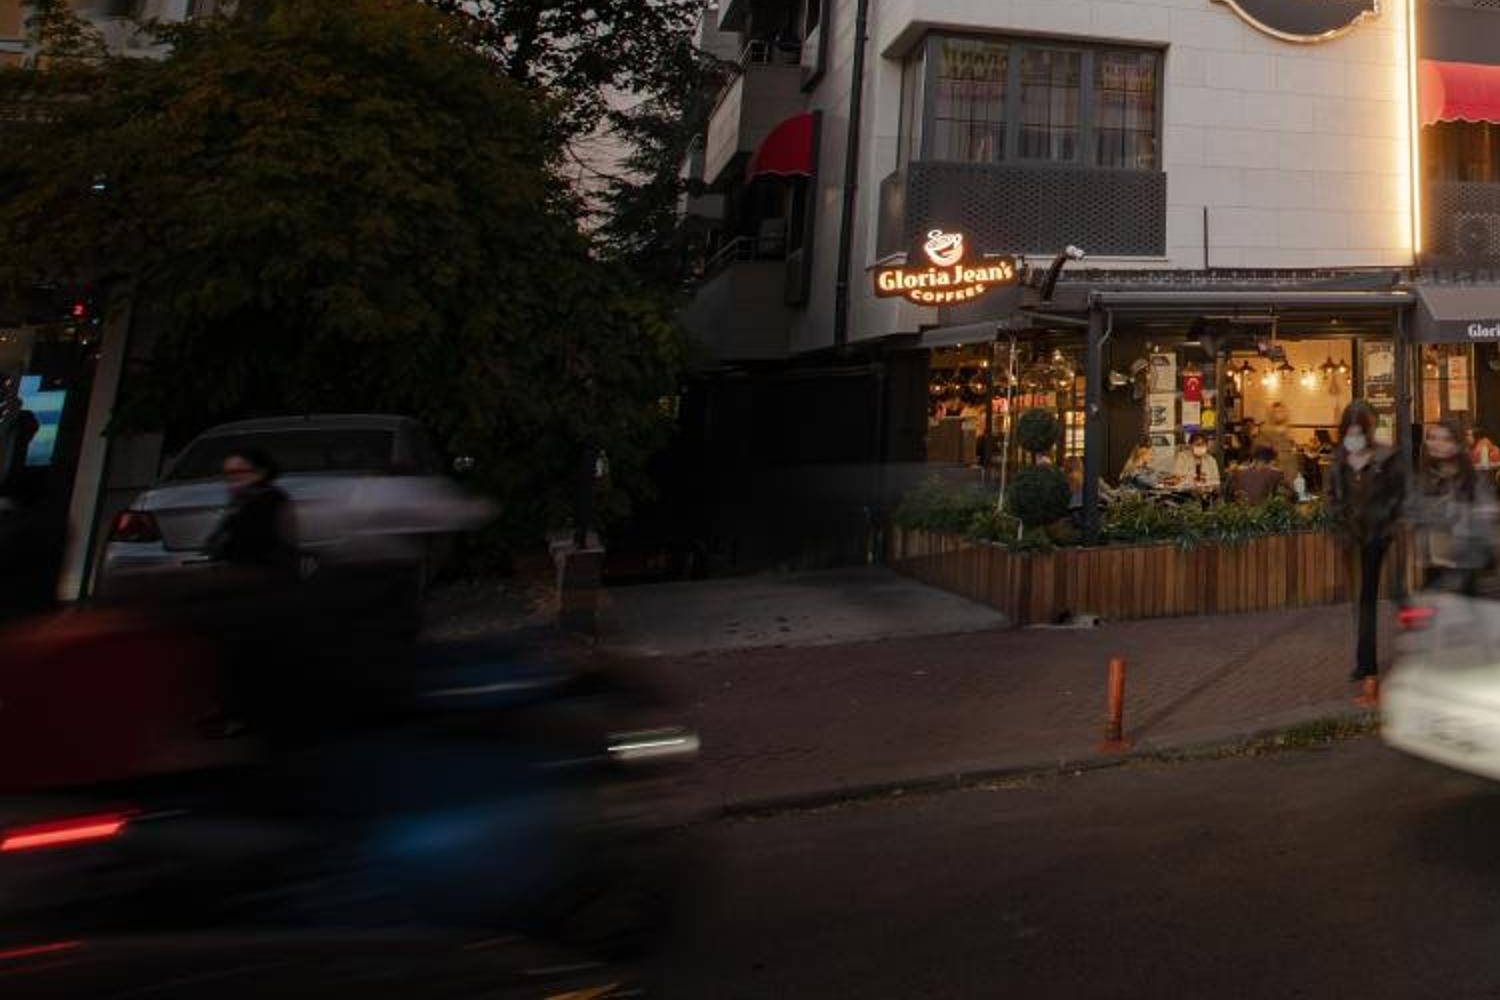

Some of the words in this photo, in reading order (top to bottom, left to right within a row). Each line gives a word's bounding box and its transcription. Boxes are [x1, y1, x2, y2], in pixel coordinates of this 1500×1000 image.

[878, 267, 951, 291] Gloria
[952, 261, 1014, 285] Jean's
[910, 283, 986, 303] COFFEES
